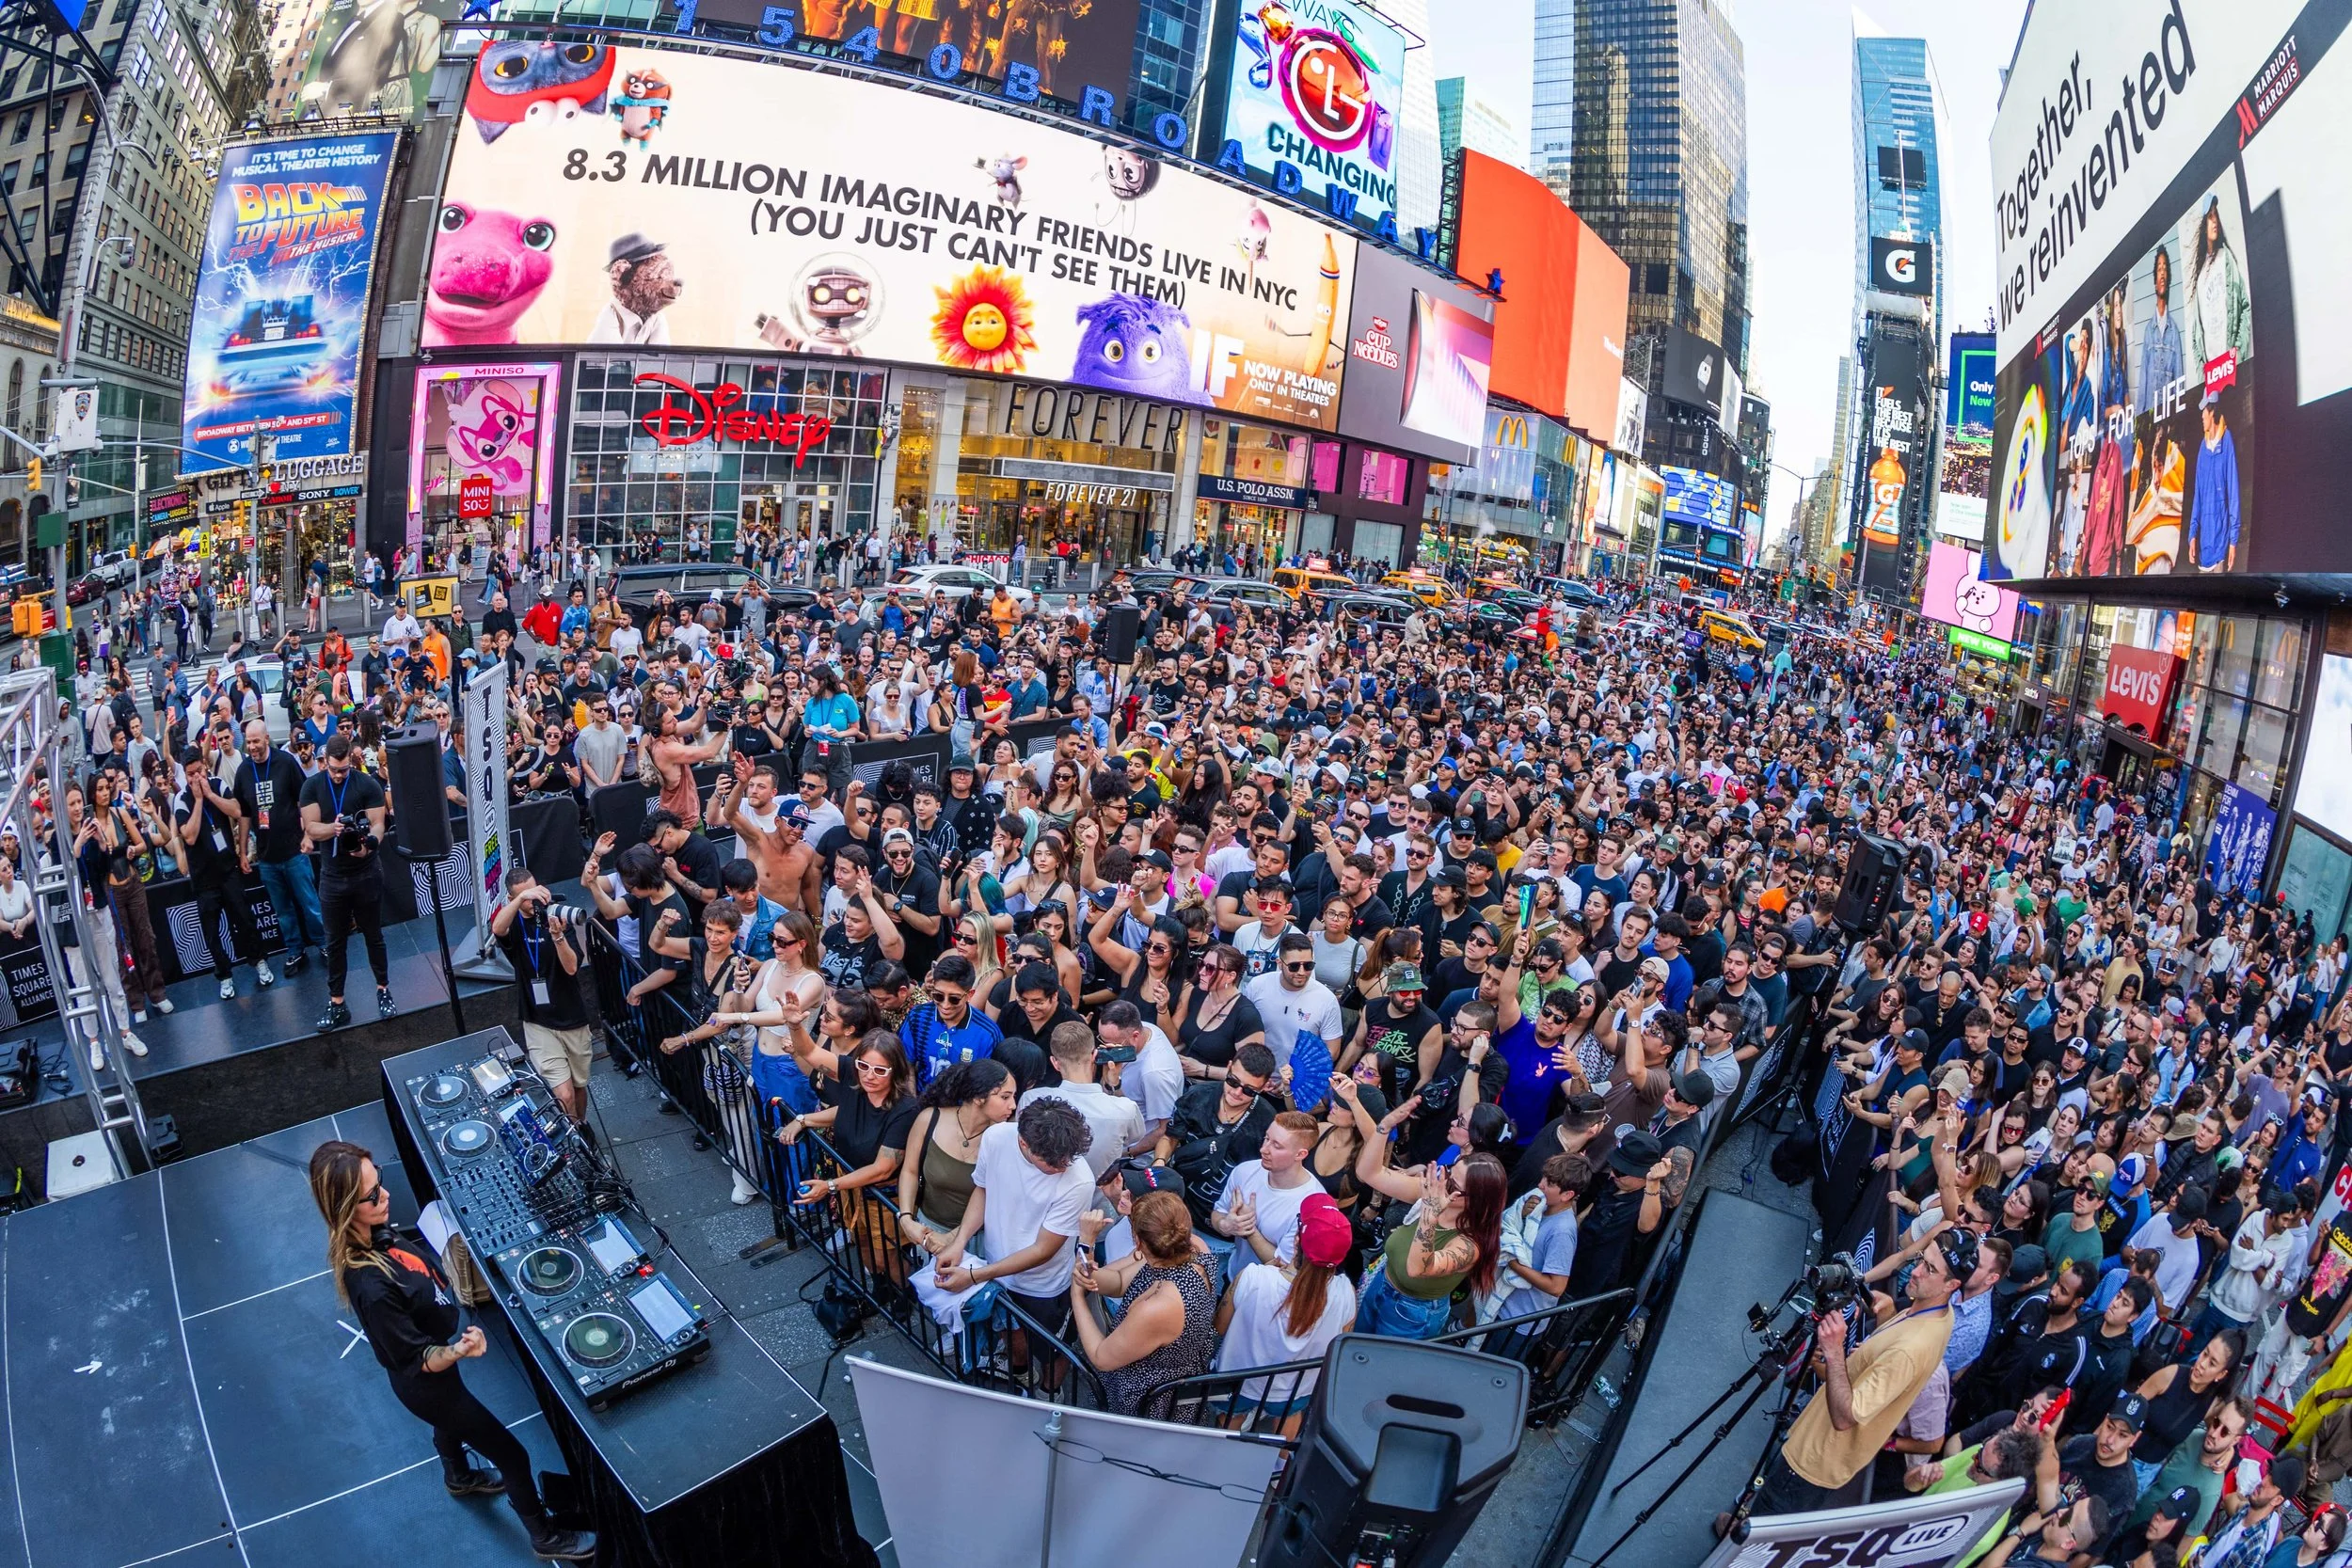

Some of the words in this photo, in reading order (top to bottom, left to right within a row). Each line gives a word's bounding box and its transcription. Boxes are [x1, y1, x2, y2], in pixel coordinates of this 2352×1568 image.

[2254, 35, 2296, 98] MARRIOTT
[2258, 62, 2297, 117] MARQUIS
[252, 152, 271, 164] IT'S
[274, 149, 299, 162] TIME
[301, 149, 316, 158] TO
[318, 144, 365, 156] CHANGE
[1997, 49, 2092, 253] Together,
[232, 163, 278, 177] MUSICAL
[281, 158, 331, 171] THEATER
[331, 154, 382, 167] HISTORY
[1999, 264, 2025, 333] we
[2029, 0, 2197, 297] reinvented
[232, 182, 331, 224] BACK
[236, 224, 260, 245] TO
[259, 208, 365, 254] FUTURE
[563, 148, 628, 182] 8.3
[641, 153, 808, 198] MILLION
[819, 173, 1027, 236] IMAGINARY
[1036, 215, 1153, 268] FRIENDS
[1162, 249, 1212, 284] LIVE
[1219, 266, 1247, 295] IN
[1253, 277, 1298, 311] NYC
[228, 242, 259, 262] THE
[290, 245, 312, 259] THE
[312, 231, 359, 251] MUSICAL
[751, 198, 845, 240] (YOU
[854, 216, 937, 254] JUST
[947, 231, 1042, 273] CAN'T
[1051, 253, 1099, 286] SEE
[1108, 265, 1185, 310] THEM)
[1366, 329, 1391, 350] CUP
[1189, 327, 1245, 398] IF
[1353, 341, 1398, 369] NOODLES
[474, 367, 524, 375] MINISO
[1244, 359, 1282, 382] NOW
[1283, 371, 1338, 397] PLAYING
[1249, 378, 1276, 393] ONLY
[1278, 385, 1288, 397] IN
[1290, 387, 1330, 406] THEATRES
[1876, 387, 1884, 397] IT
[1970, 380, 1994, 395] Only
[1875, 397, 1902, 410] FUELS
[1970, 395, 1993, 406] New
[1005, 382, 1184, 453] FOREVER
[1874, 416, 1912, 433] BECAUSE
[1876, 407, 1892, 419] THE
[1891, 410, 1914, 424] BEST
[2069, 424, 2096, 461] TOPS
[2108, 404, 2135, 443] FOR
[2153, 375, 2186, 423] LIFE
[198, 425, 235, 438] BROADWAY
[280, 435, 301, 444] THEATRE
[1873, 425, 1882, 436] IT
[1882, 427, 1891, 438] IS
[1873, 436, 1889, 448] THE
[1889, 438, 1912, 453] BEST
[274, 455, 364, 482] LUGGAGE
[262, 495, 293, 504] Canon
[298, 489, 331, 500] SONY
[334, 487, 358, 497] BOWER
[463, 485, 489, 498] MINI
[1044, 482, 1116, 506] FOREVER
[1120, 489, 1136, 506] 21
[1216, 479, 1234, 493] U.S.
[1236, 482, 1264, 496] POLO
[1266, 485, 1295, 500] ASSN.
[151, 493, 188, 510] ELECTRONICS
[169, 507, 188, 517] LUGGAGE
[1957, 632, 1979, 645] NEW
[1983, 640, 2006, 655] YORK
[2219, 805, 2230, 816] LIFE
[2222, 794, 2232, 807] FOR
[485, 836, 498, 858] FREE
[484, 846, 501, 873] MUSIC
[11, 963, 45, 982] TIMES
[13, 974, 54, 997] SQUARE
[21, 990, 55, 1008] ALLIANCE
[622, 1364, 662, 1389] Pioneer
[665, 1358, 677, 1371] DJ
[1902, 1524, 1955, 1545] LIVE
